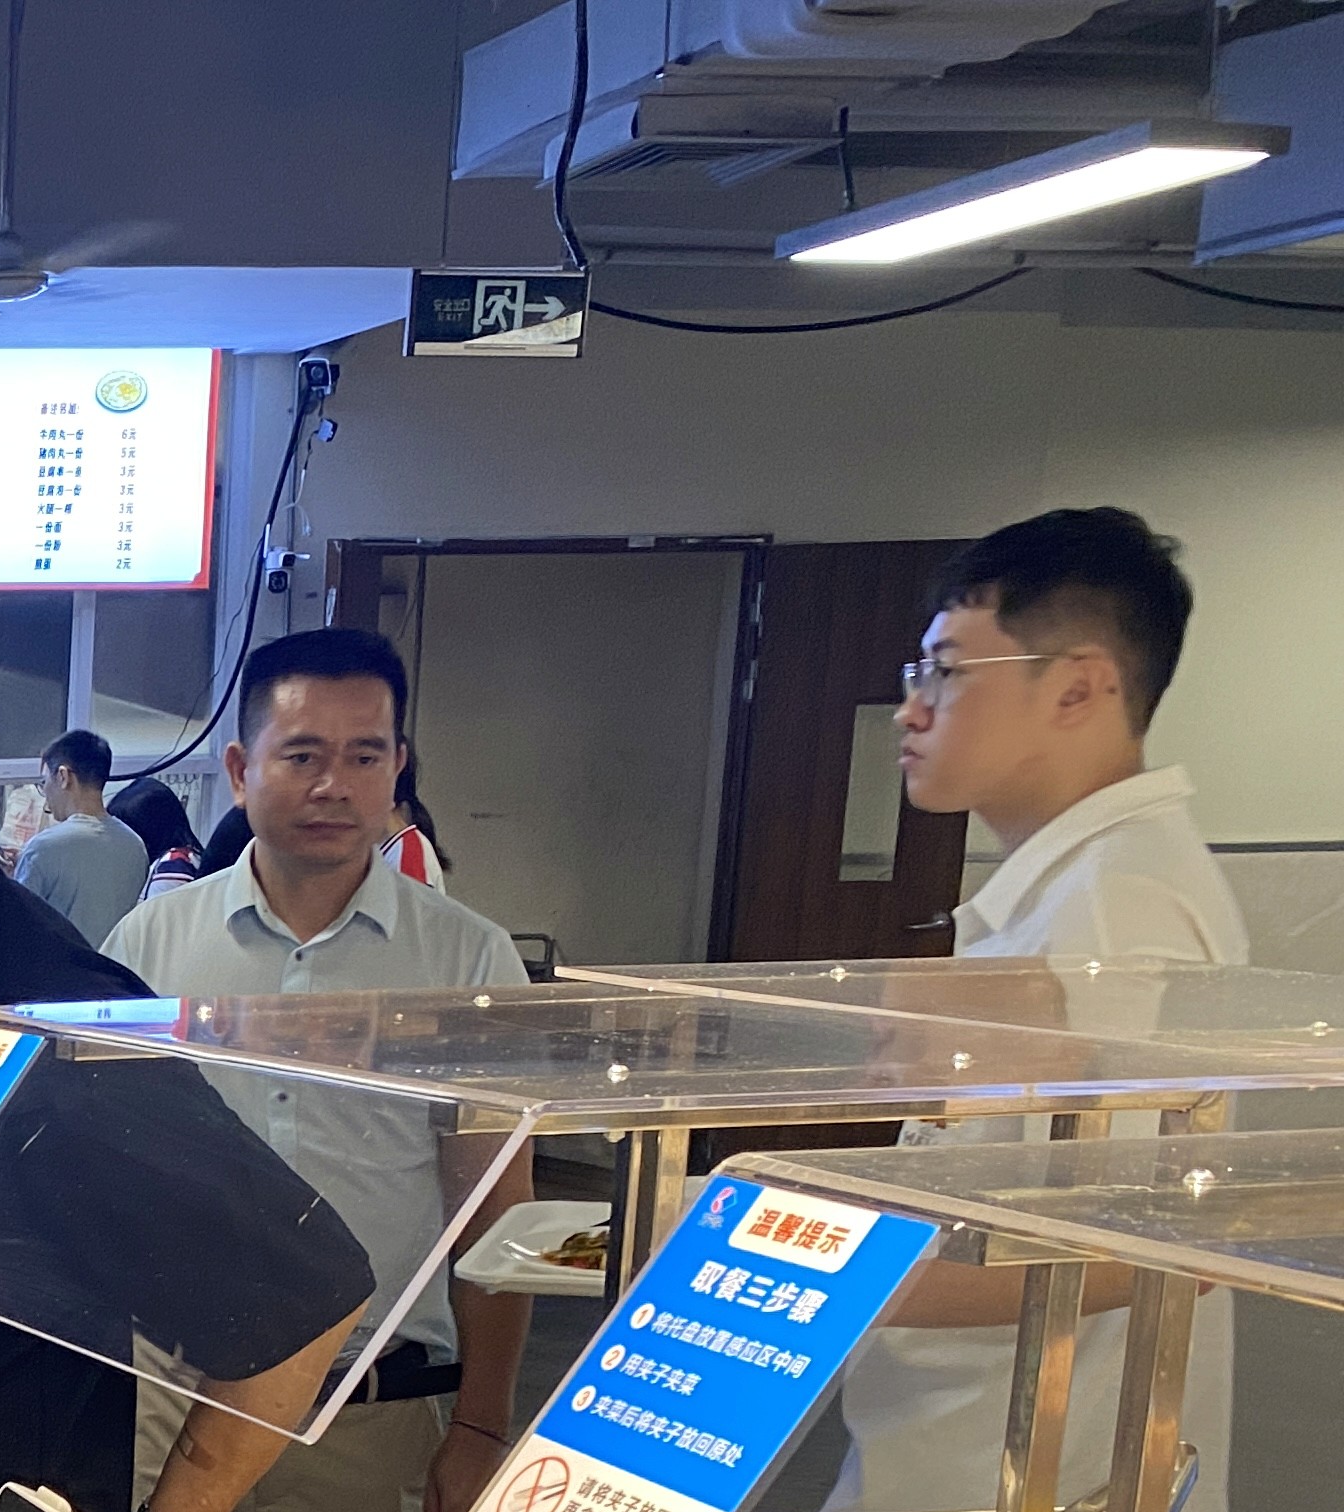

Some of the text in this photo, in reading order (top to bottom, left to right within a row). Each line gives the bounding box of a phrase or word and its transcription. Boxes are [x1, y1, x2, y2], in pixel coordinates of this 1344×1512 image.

[122, 428, 136, 440] 6元
[121, 447, 136, 458] 5元
[120, 465, 135, 477] 3元
[120, 484, 134, 495] 3元
[119, 503, 133, 514] 3元
[118, 521, 133, 533] 3元
[117, 539, 132, 551] 3元
[116, 558, 131, 570] 2元
[747, 1208, 851, 1255] 温馨提示
[690, 1260, 828, 1323] 取餐三步骤
[651, 1312, 811, 1378] 将托盘放置感应区中间
[621, 1353, 702, 1395] 用夹子夹菜
[591, 1396, 744, 1467] 夹菜后将夹子放回原处
